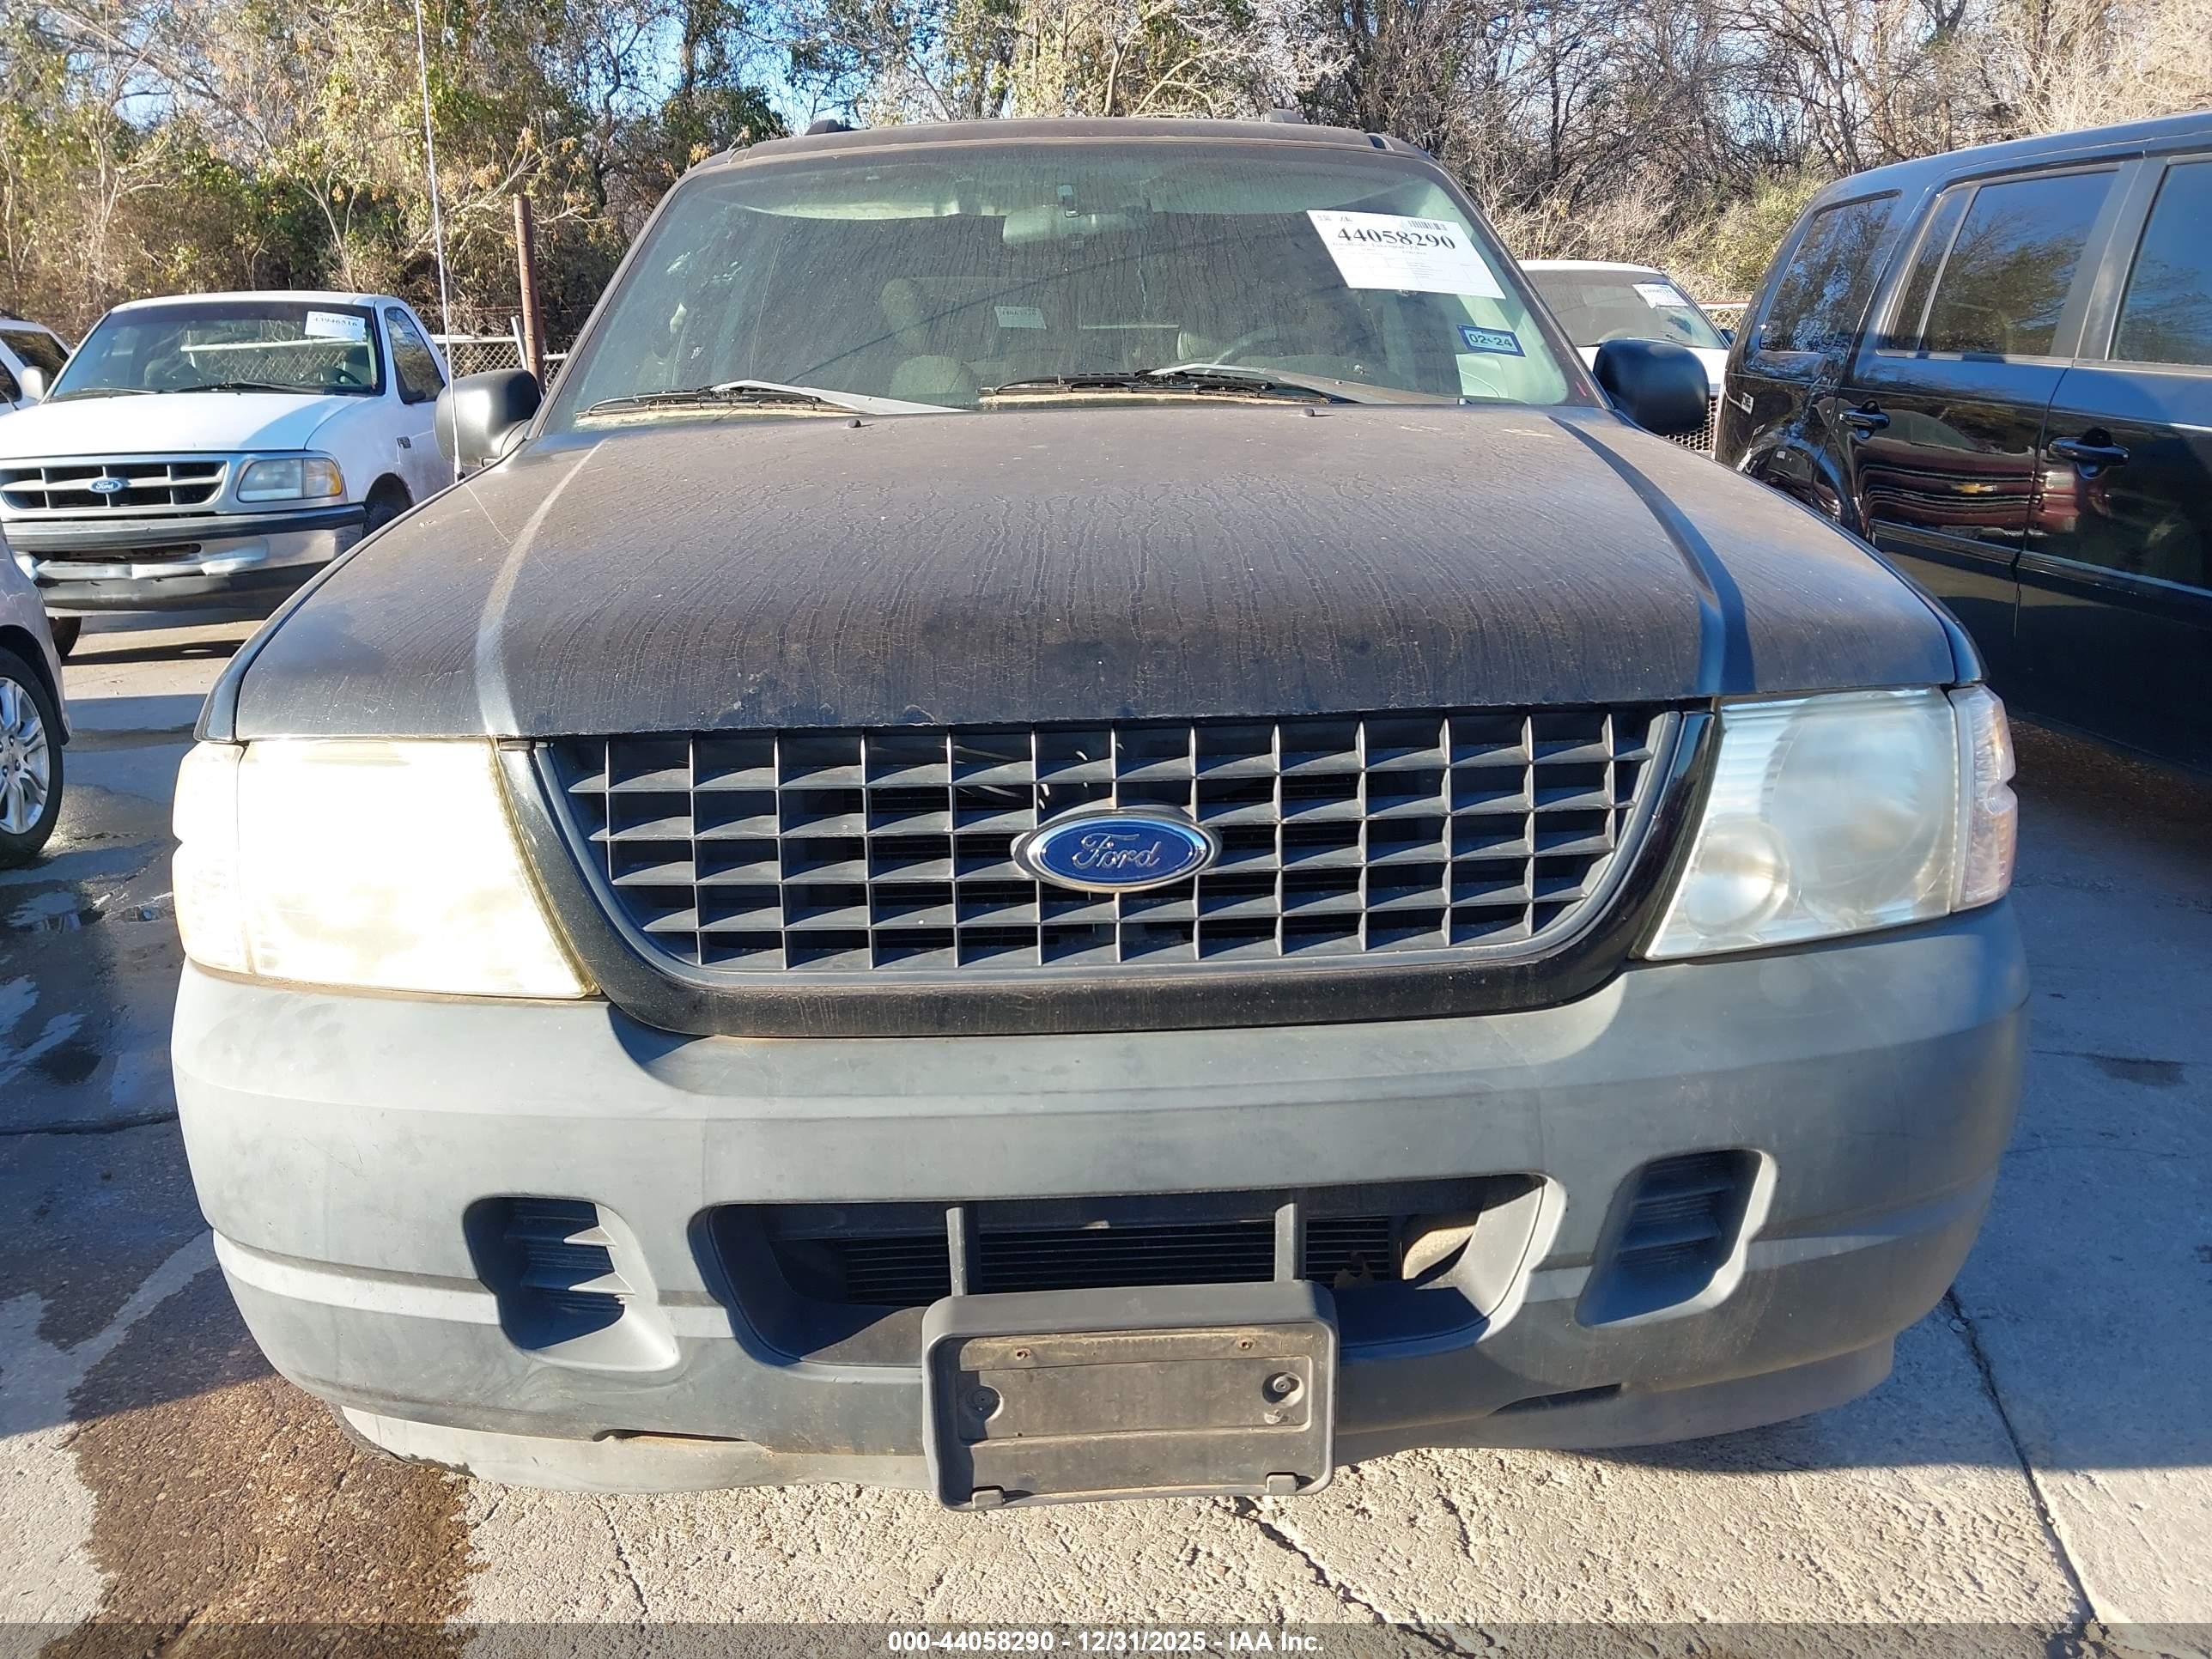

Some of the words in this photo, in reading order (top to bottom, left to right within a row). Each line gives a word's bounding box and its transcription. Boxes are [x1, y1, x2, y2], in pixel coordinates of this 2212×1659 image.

[1337, 227, 1456, 250] 44058290
[95, 481, 114, 489] Ford
[1072, 832, 1162, 869] Ford
